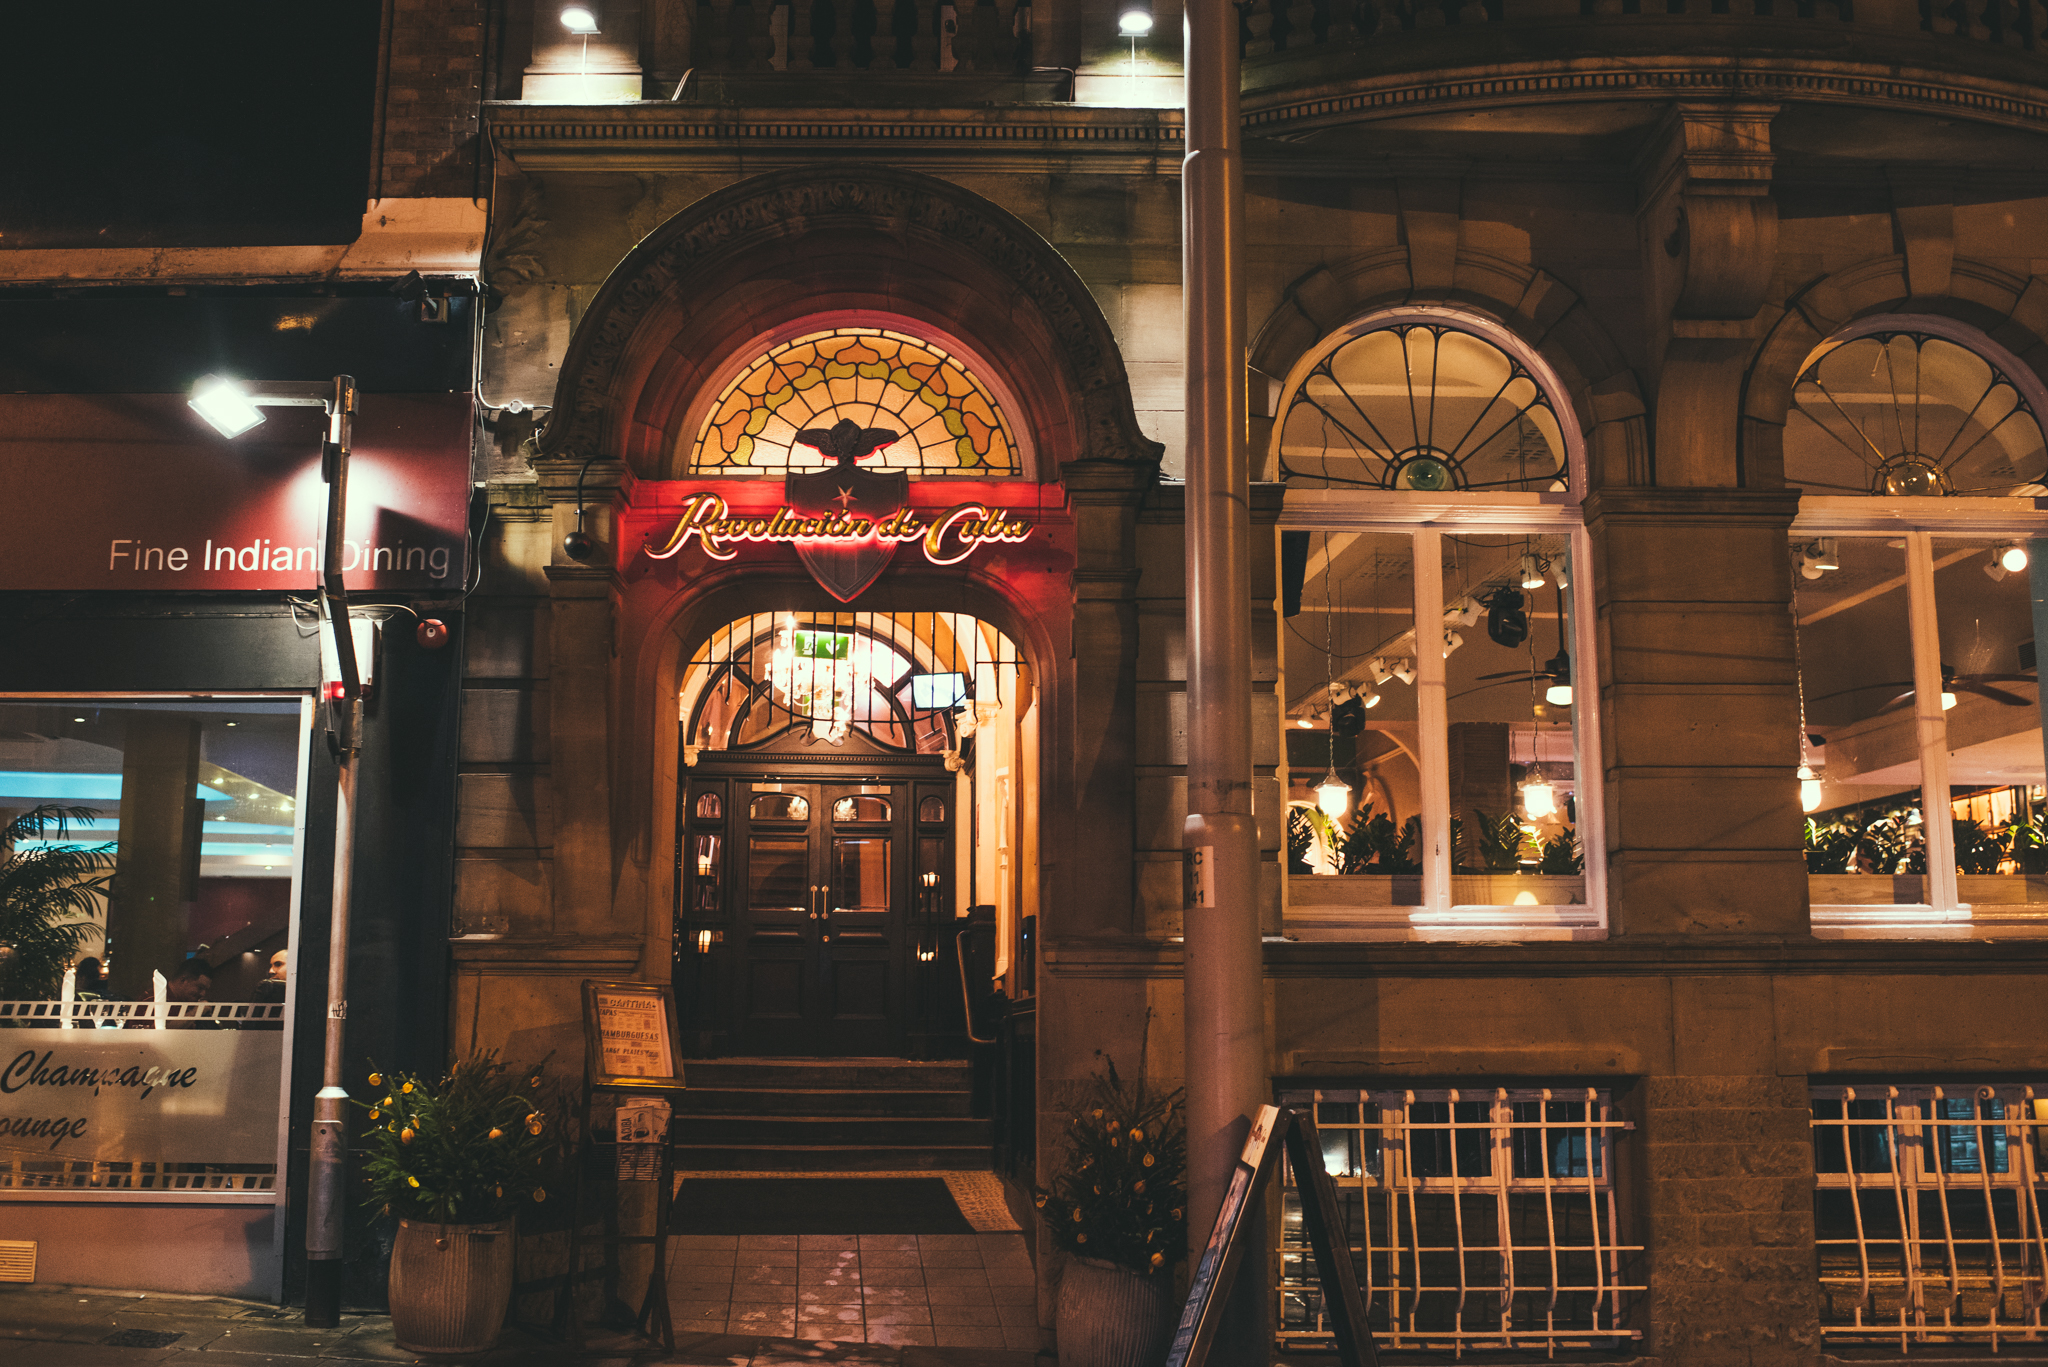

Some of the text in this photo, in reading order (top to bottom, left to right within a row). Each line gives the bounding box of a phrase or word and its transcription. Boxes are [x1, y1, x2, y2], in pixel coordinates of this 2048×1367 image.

[644, 492, 1034, 566] Revolución de Cuba
[109, 539, 188, 571] Fine
[203, 539, 317, 571] Indian
[1186, 852, 1203, 866] RC
[1189, 871, 1199, 885] 11
[601, 1030, 659, 1041] HAMBURGUESAS
[1, 1050, 197, 1100] Champagne
